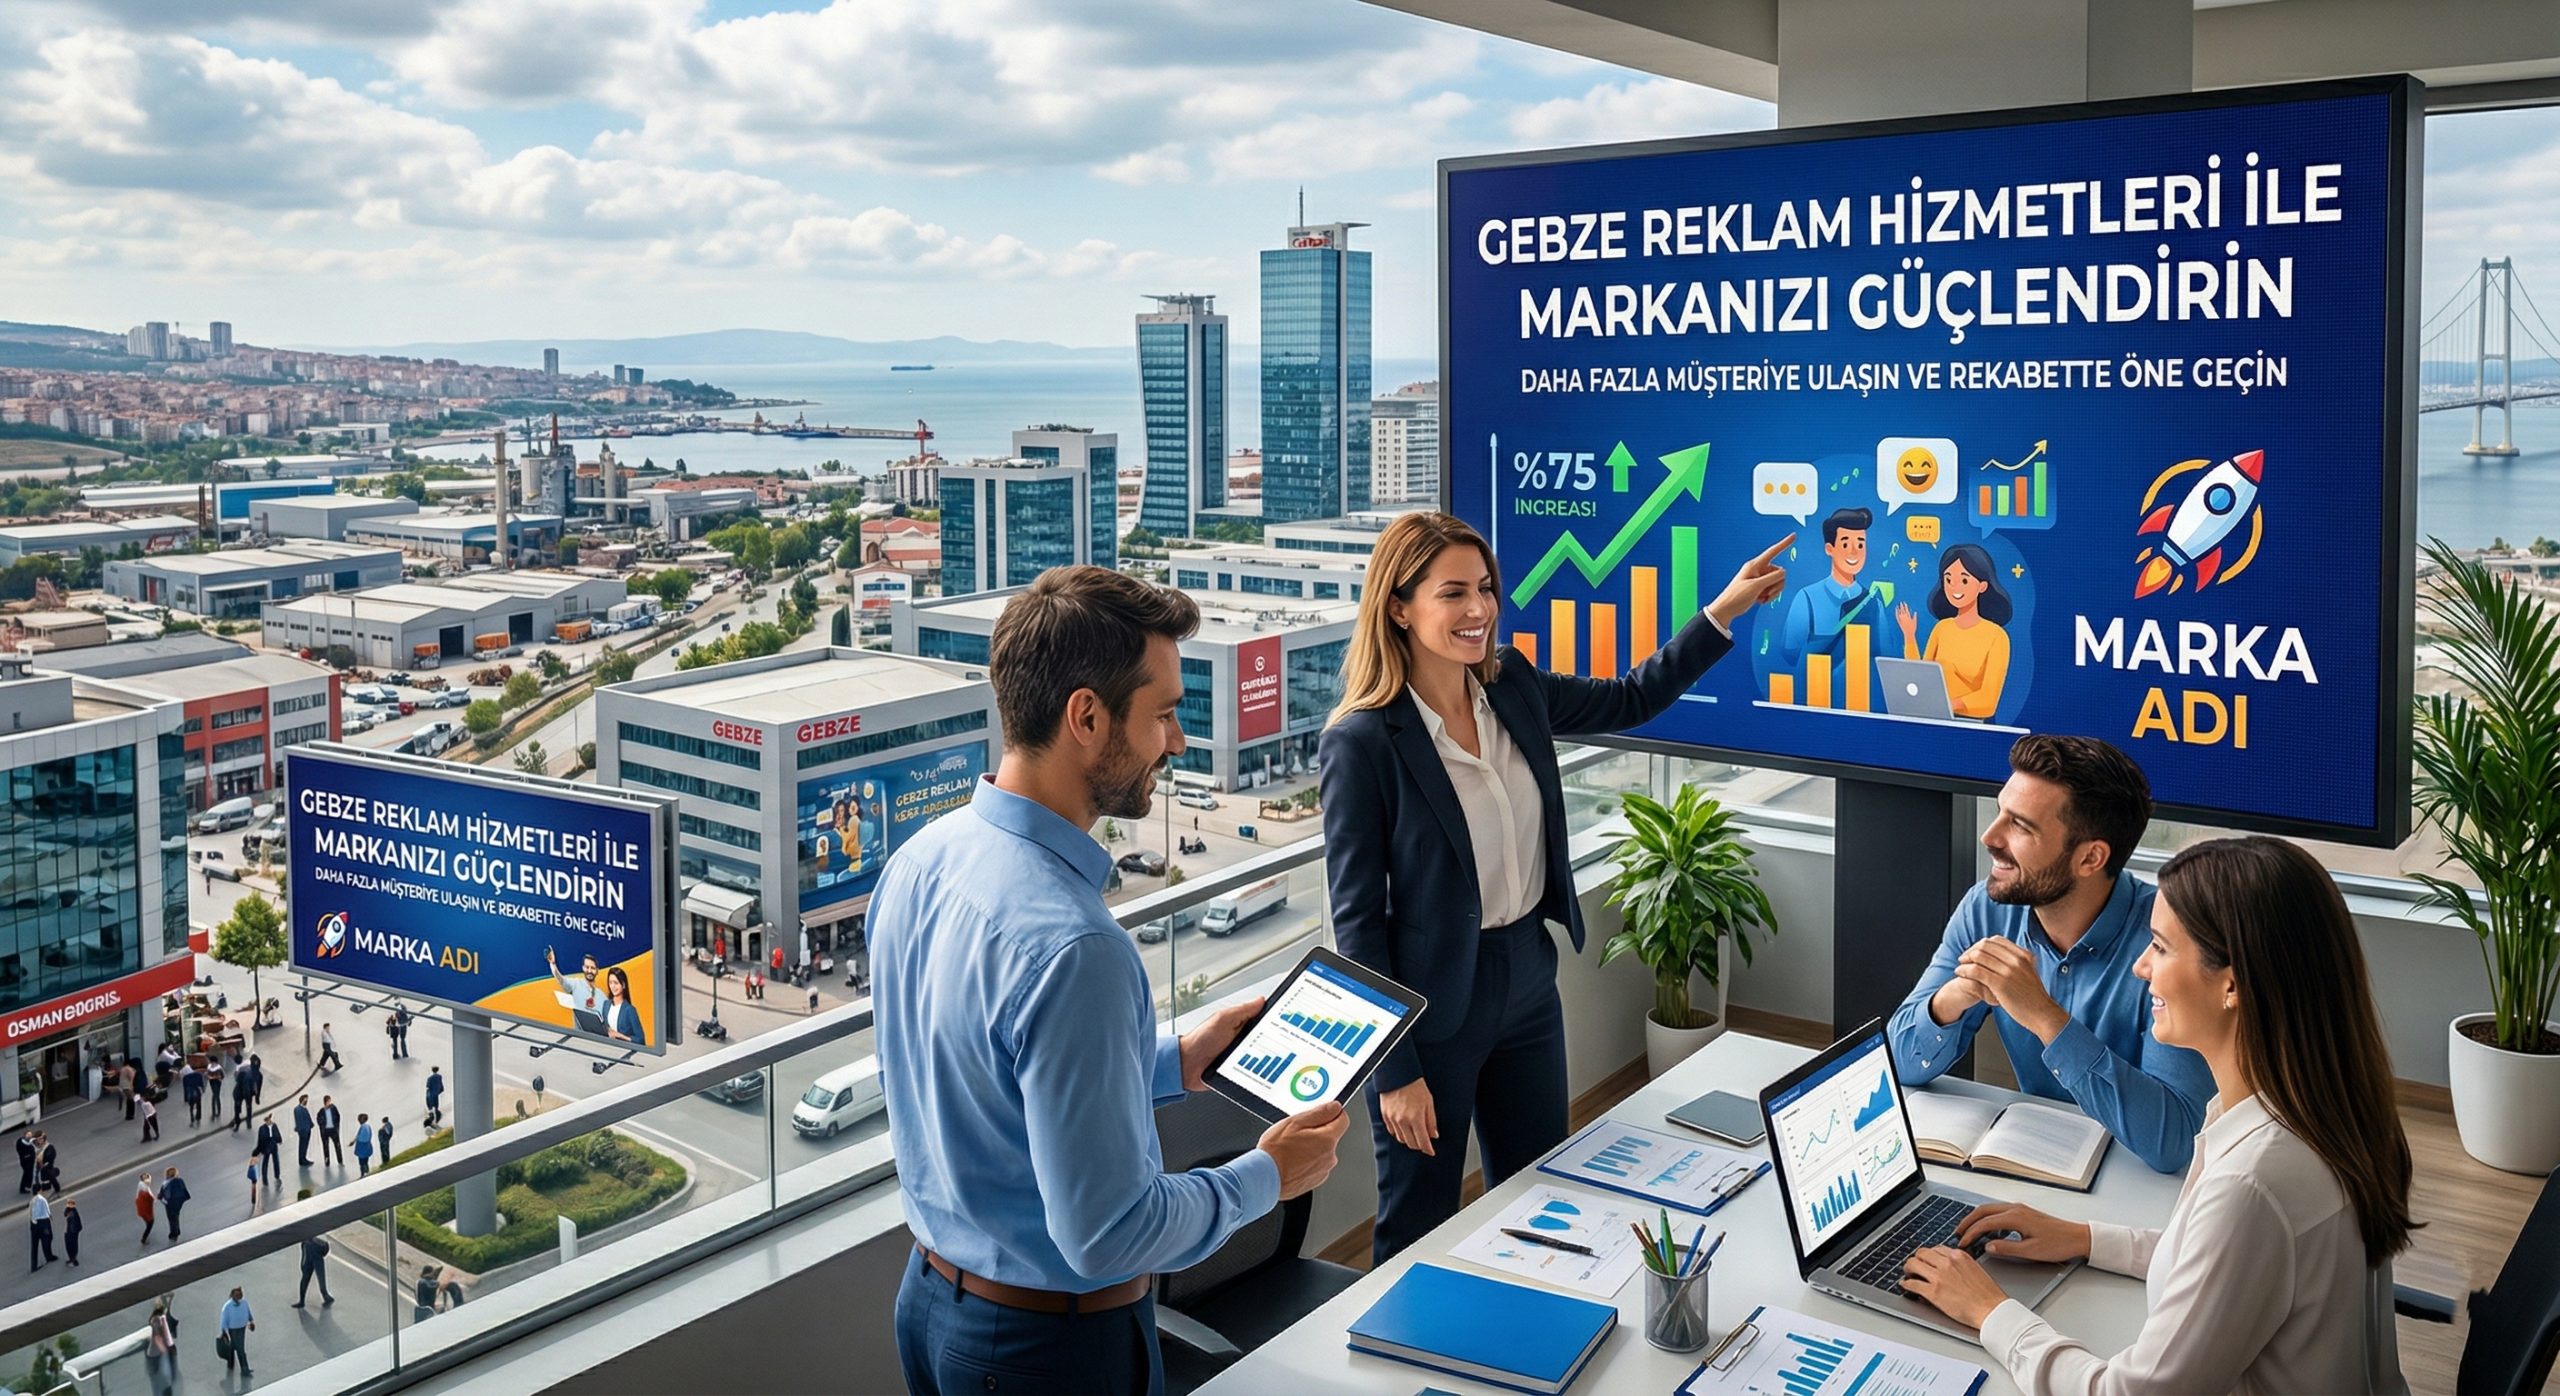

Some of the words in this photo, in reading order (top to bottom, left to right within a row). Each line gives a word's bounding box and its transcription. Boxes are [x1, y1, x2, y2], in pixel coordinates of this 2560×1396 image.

[1478, 211, 1627, 266] GEBZE
[1643, 197, 1851, 257] REKLAM
[1870, 154, 2221, 246] HİZMETLERİ
[2245, 151, 2342, 227] İLE
[1520, 276, 1829, 339] MARKANIZI
[1848, 240, 2293, 345] GÜÇLENDİRİN
[1521, 367, 1584, 393] DAHA
[1589, 367, 1661, 393] FAZLA
[1667, 358, 1800, 398] MÜŞTERİYE
[1808, 362, 1900, 398] ULAŞIN
[1906, 362, 1941, 390] VE
[1949, 359, 2111, 390] REKABETTE
[2120, 352, 2184, 388] ÖNE
[2192, 349, 2288, 396] GEÇİN
[1513, 451, 1597, 491] %75
[1514, 497, 1597, 517] INCREAS!
[2075, 613, 2319, 685] MARKA
[711, 718, 763, 746] GEBZE
[796, 714, 862, 744] GEBZE
[2131, 686, 2248, 750] ADI
[300, 788, 368, 823] GEBZE
[373, 799, 460, 839] REKLAM
[465, 811, 598, 864] HİZMETLERİ
[604, 831, 640, 871] İLE
[314, 826, 446, 878] MARKANIZI
[452, 849, 625, 911] GÜÇLENDİRİN
[315, 866, 345, 885] DAHA
[346, 872, 379, 892] FAZLA
[380, 877, 440, 903] MÜŞTERİYE
[440, 890, 480, 912] ULAŞIN
[481, 898, 497, 914] VE
[498, 901, 562, 928] REKABETTE
[563, 910, 589, 932] ÖNE
[590, 919, 626, 941] GEÇİN
[353, 926, 436, 967] MARKA
[439, 945, 480, 975] ADI
[7, 1008, 63, 1039] OSMAN
